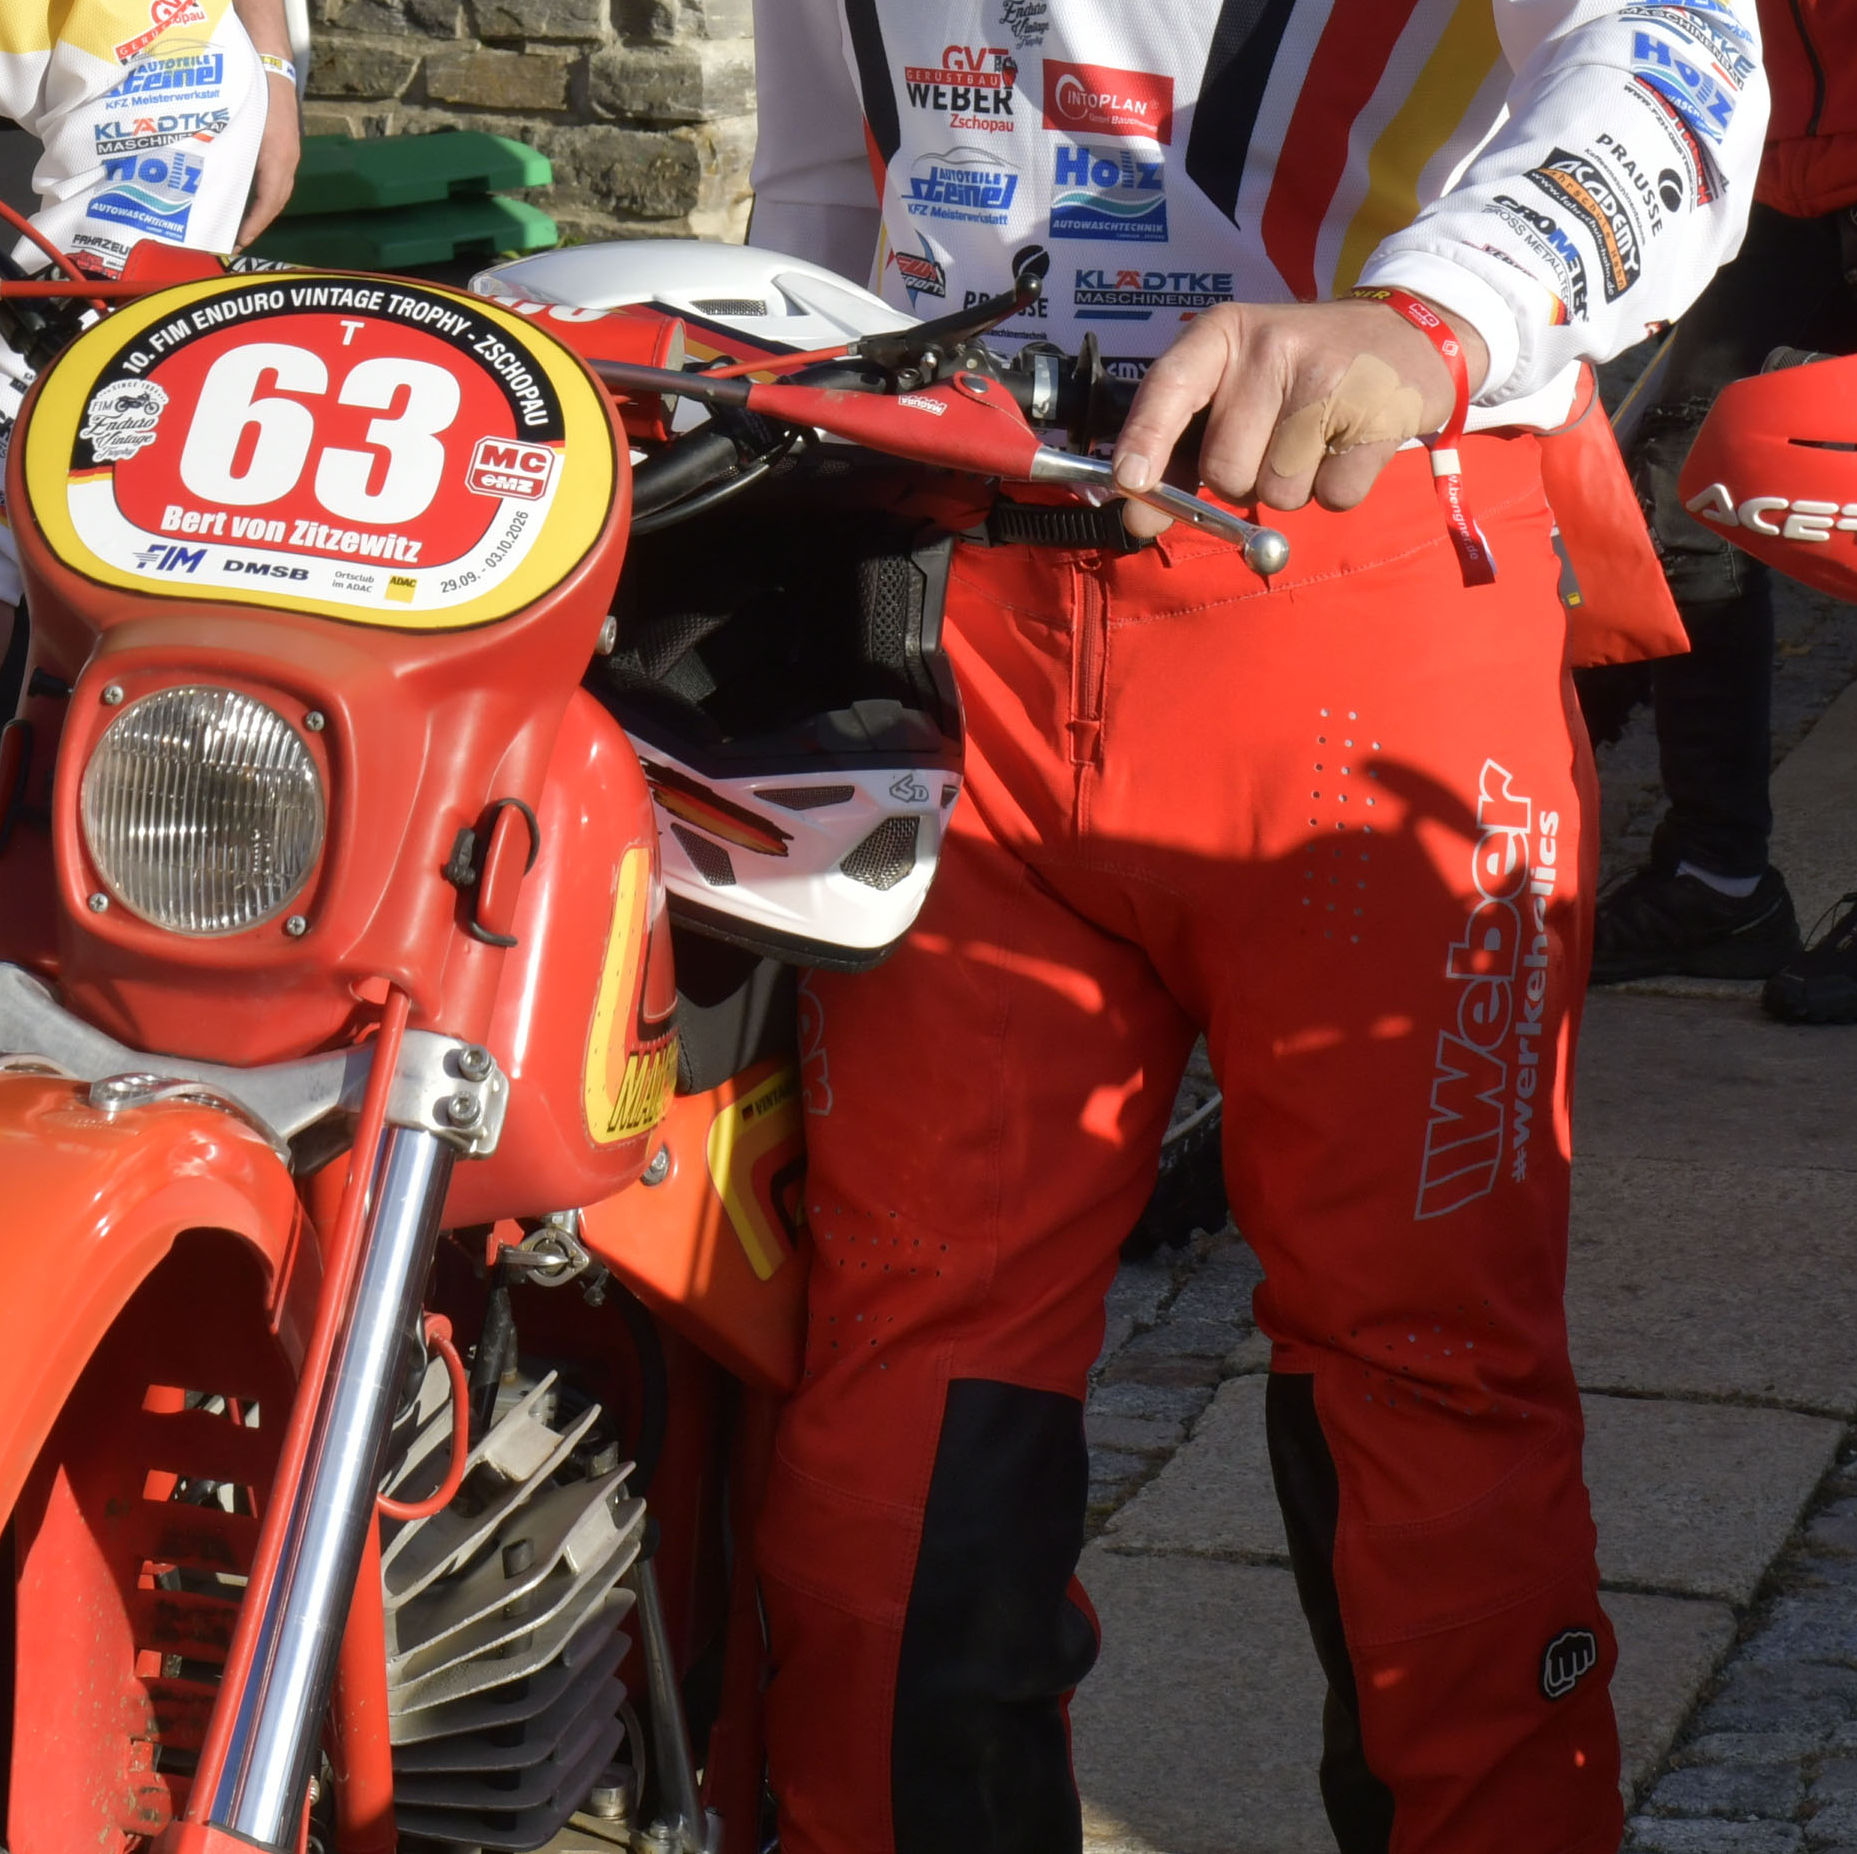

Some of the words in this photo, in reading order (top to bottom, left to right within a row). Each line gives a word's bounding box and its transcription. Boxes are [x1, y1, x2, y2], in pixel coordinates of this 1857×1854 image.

[131, 89, 221, 108] Meisterwerkstatt
[906, 82, 1014, 115] WEBER
[1067, 90, 1148, 115] INTOPLAN
[950, 113, 1015, 134] Zschopau
[1055, 146, 1166, 190] Holz
[1595, 132, 1664, 238] PRAUSSE
[91, 201, 185, 235] AUTOWASCHTECHNIK
[908, 204, 928, 217] KFZ
[930, 206, 1009, 226] Meisterwerkstatt
[1053, 219, 1165, 234] AUTOWASCHTECHNIK
[1549, 159, 1640, 273] ACADEMY
[72, 233, 131, 256] FAHRZEU
[1075, 291, 1234, 308] MASCHINENBAU
[339, 319, 365, 346] T
[149, 317, 193, 353] FIM
[195, 289, 287, 332] ENDURO
[290, 287, 387, 312] VINTAGE
[388, 293, 472, 337] TROPHY
[472, 333, 550, 428] ZSCHOPAU
[82, 413, 155, 436] Enduro
[179, 342, 462, 525] 63
[95, 431, 154, 449] Vintage
[480, 442, 547, 475] MC
[160, 504, 227, 536] Bert
[231, 515, 285, 545] von
[288, 519, 423, 565] Zitzewitz
[485, 509, 531, 570] 03.10.2026
[132, 543, 209, 575] FIM
[223, 559, 310, 583] DMSB
[334, 569, 376, 585] Ortsclub
[345, 580, 373, 594] ADAC
[389, 574, 418, 590] ADAC
[1413, 757, 1532, 1221] Weber
[1510, 809, 1561, 1184] #werkeholics
